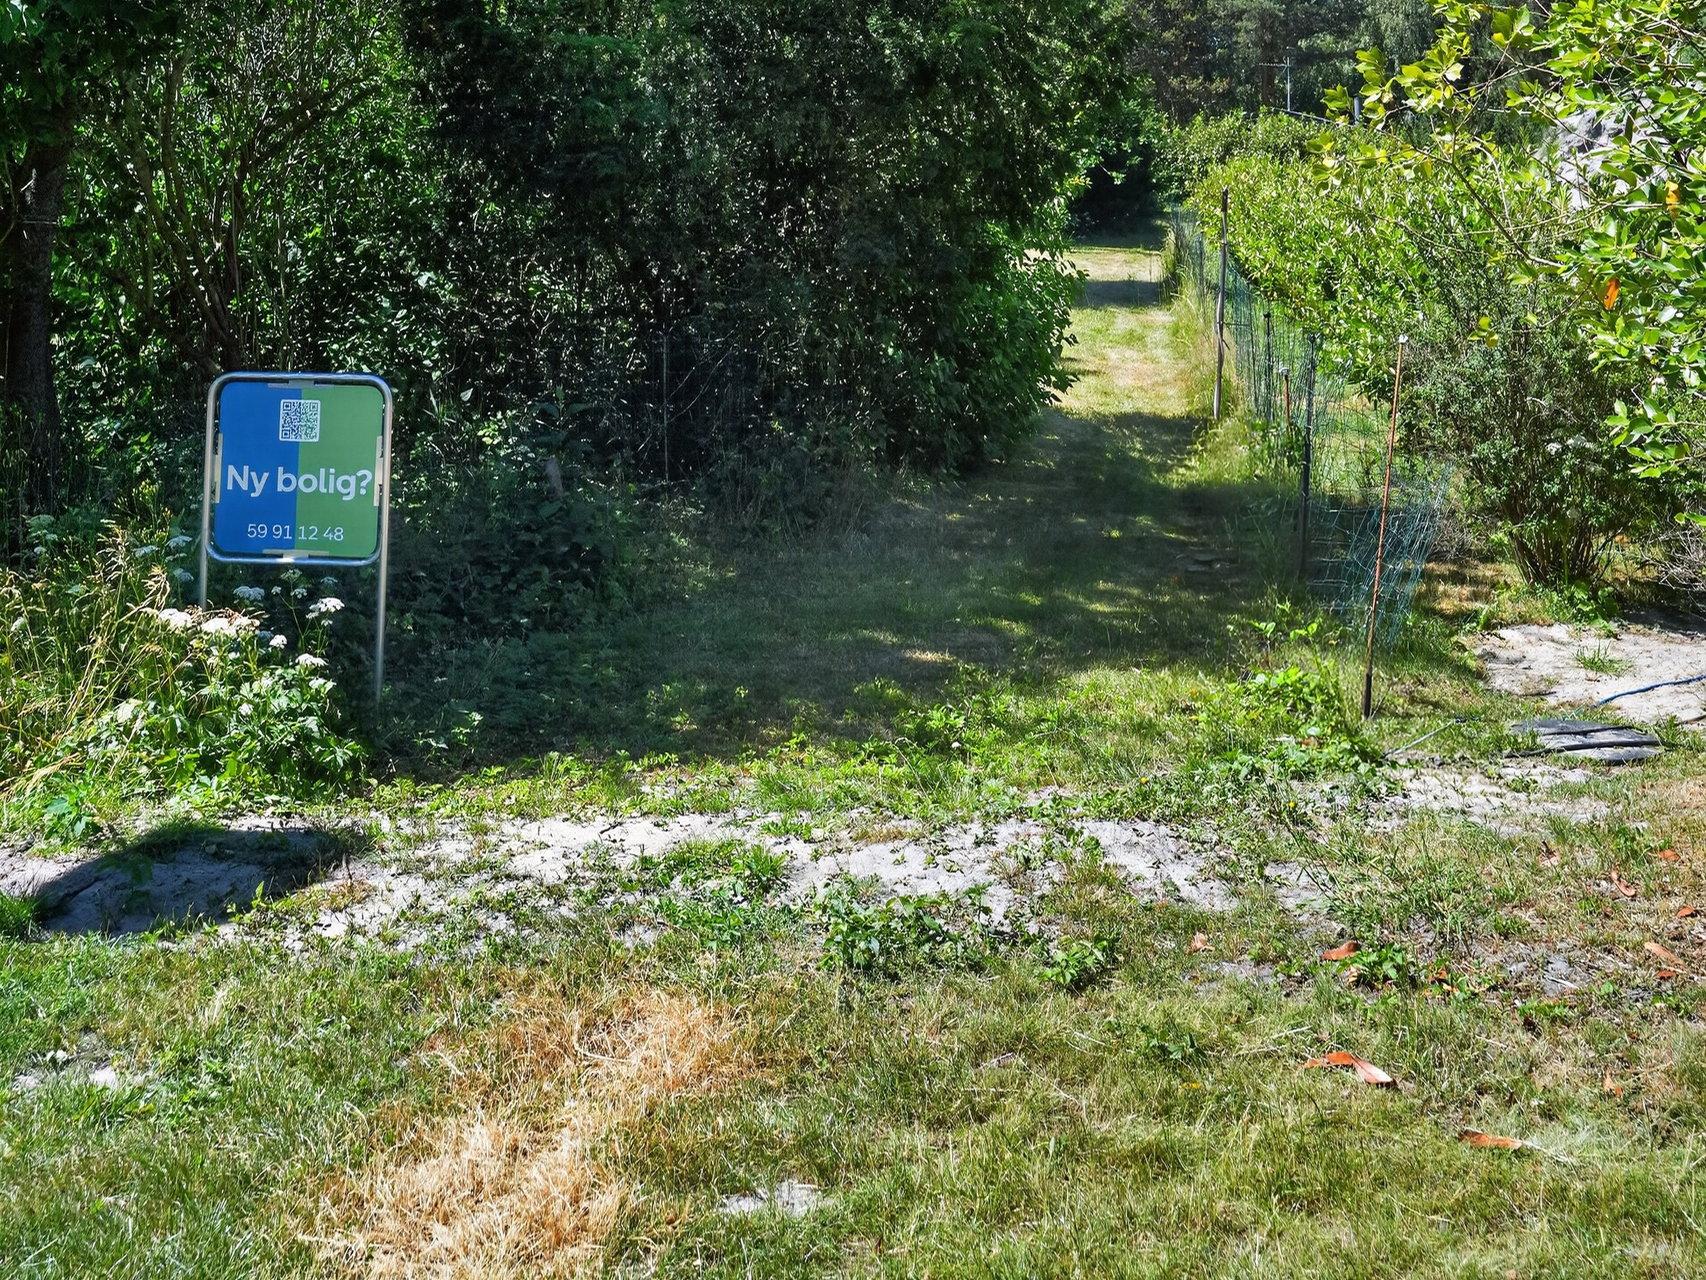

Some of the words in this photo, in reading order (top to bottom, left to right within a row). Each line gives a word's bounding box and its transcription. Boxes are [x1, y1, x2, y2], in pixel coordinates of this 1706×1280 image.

[226, 464, 269, 498] Ny
[276, 466, 373, 501] bolig?
[247, 523, 268, 538] 59
[272, 524, 292, 540] 91
[298, 525, 318, 540] 12
[323, 526, 344, 541] 48
